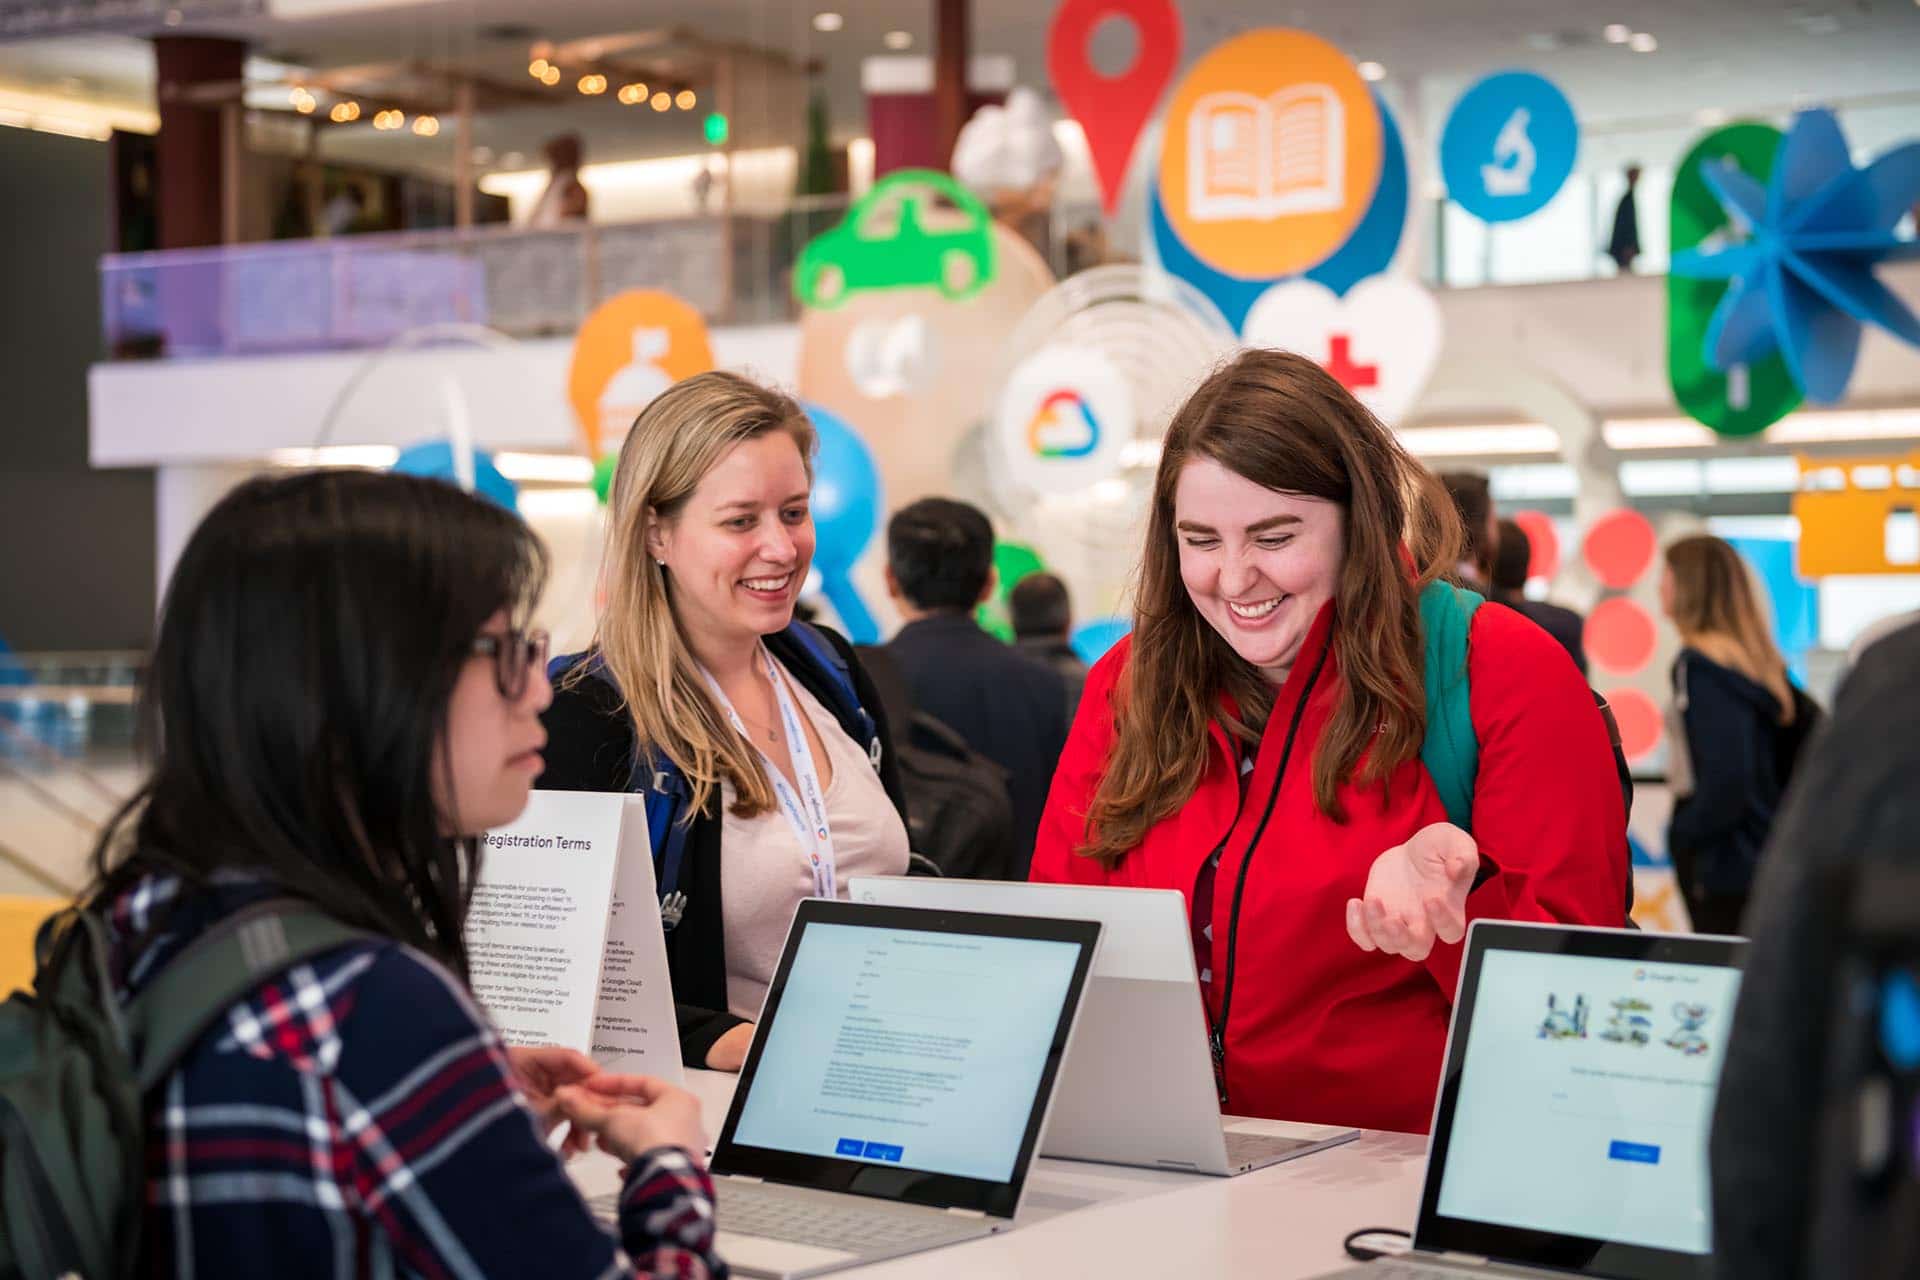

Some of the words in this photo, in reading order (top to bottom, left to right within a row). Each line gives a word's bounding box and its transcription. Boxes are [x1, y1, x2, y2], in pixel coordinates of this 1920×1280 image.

[482, 832, 553, 849] Registration
[555, 836, 592, 850] Terms
[513, 894, 546, 903] participating
[494, 902, 512, 910] Google
[524, 954, 542, 962] Google
[510, 972, 527, 980] eligible
[606, 977, 625, 986] Google
[535, 988, 554, 996] Google
[555, 989, 570, 997] Cloud
[499, 994, 527, 1002] registration
